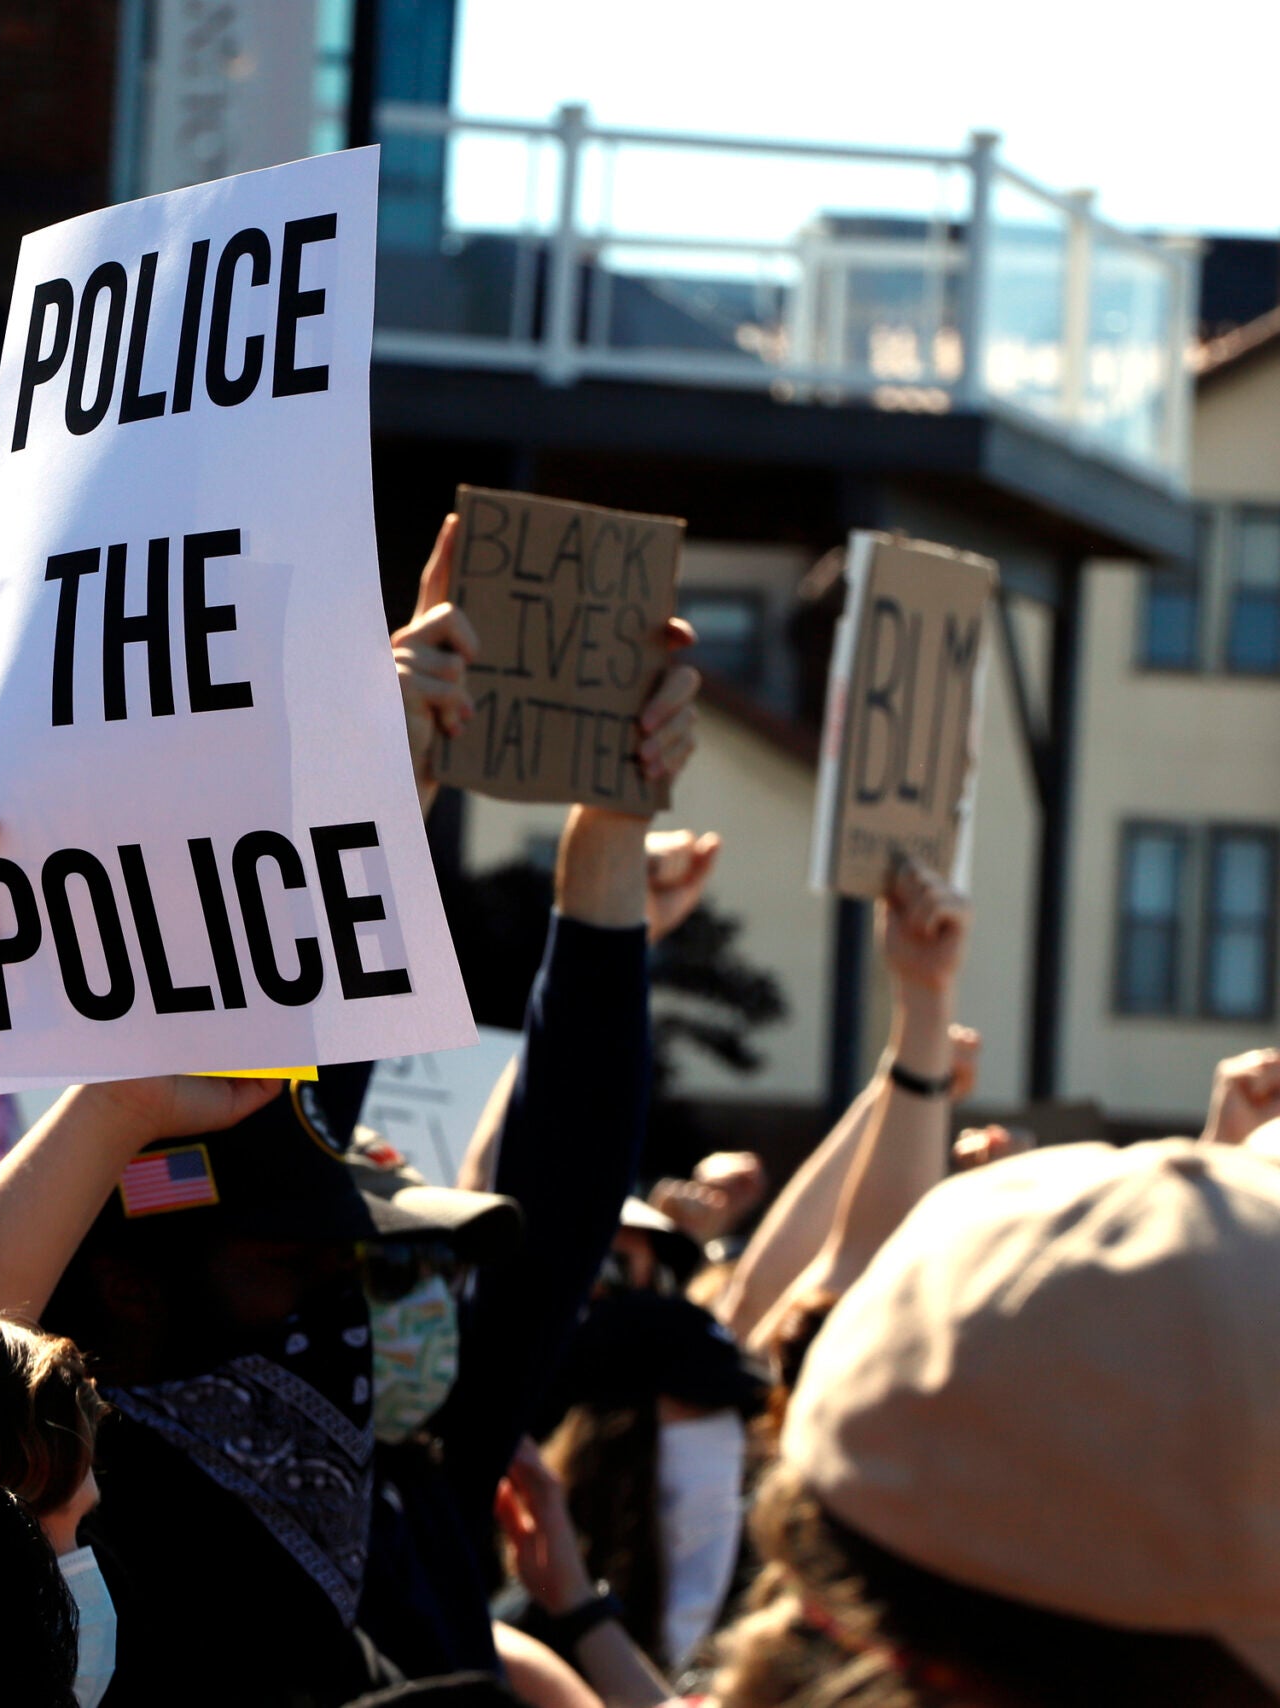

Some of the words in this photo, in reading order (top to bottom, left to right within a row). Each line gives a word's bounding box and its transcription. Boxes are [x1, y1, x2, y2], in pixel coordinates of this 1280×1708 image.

[11, 213, 337, 453] POLICE
[44, 528, 254, 726] THE
[460, 498, 656, 598] BLACK
[441, 690, 650, 800] MATTER
[856, 595, 982, 820] BLM
